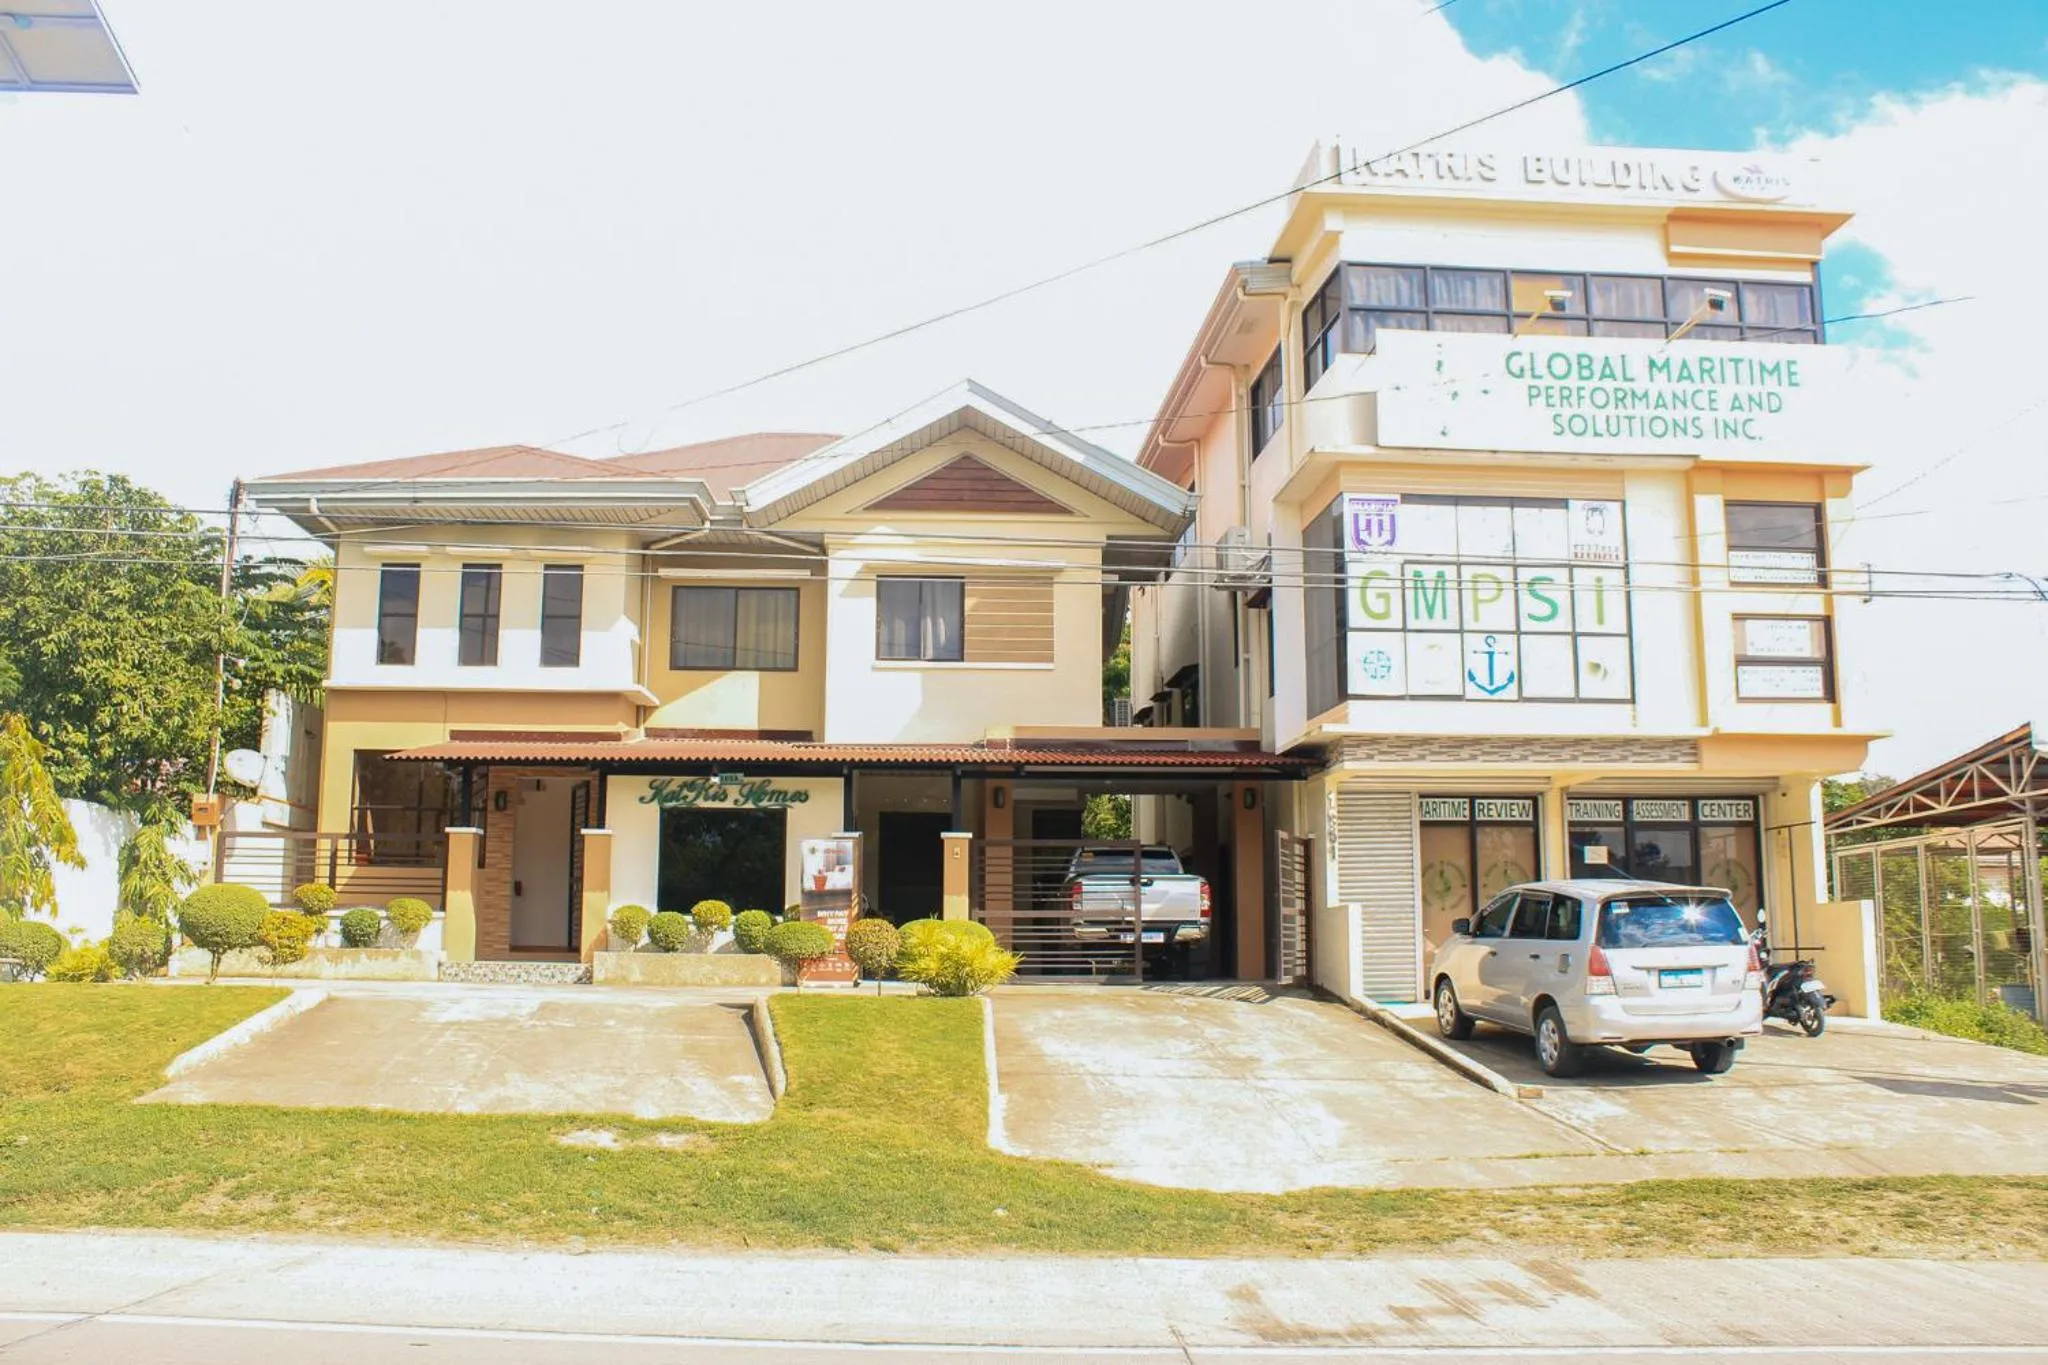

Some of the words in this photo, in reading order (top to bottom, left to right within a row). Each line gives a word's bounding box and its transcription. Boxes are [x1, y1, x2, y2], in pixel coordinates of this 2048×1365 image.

[1522, 154, 1704, 194] BUILDING
[1503, 351, 1636, 383] GLOBAL
[1648, 354, 1801, 387] MARITIME
[1526, 384, 1720, 412] PERFORMANCE
[1729, 391, 1783, 414] AND
[1552, 413, 1704, 439] SOLUTIONS
[1713, 417, 1764, 441] INC.
[1477, 801, 1532, 818] REVIEW
[1568, 801, 1621, 818] TRAINING
[1635, 802, 1687, 819] ASSESSMENT
[1700, 802, 1751, 818] CENTER
